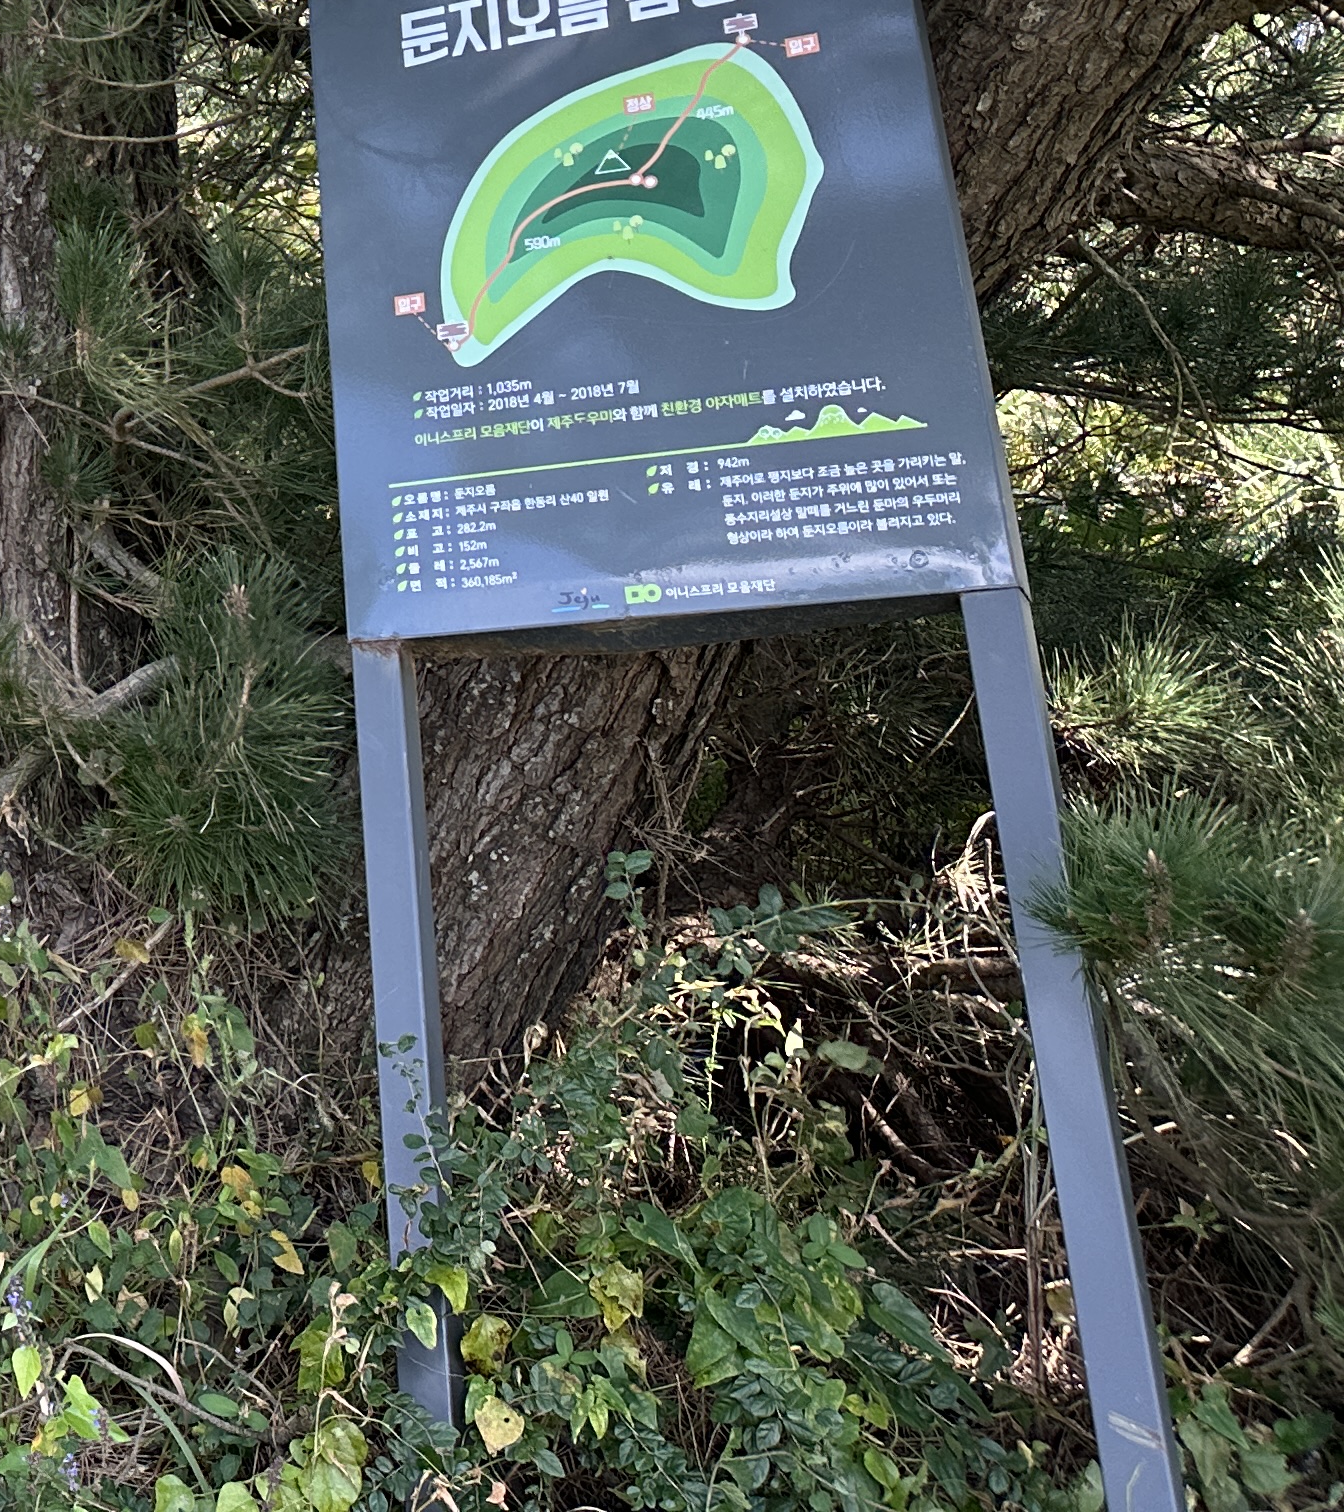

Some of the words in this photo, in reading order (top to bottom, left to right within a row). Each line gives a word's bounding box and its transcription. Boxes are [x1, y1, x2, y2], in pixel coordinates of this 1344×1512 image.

[788, 36, 815, 54] 입구
[626, 95, 652, 113] 정상
[696, 104, 734, 120] 445m
[524, 236, 561, 250] 590m
[425, 385, 474, 403] 작업거리
[486, 379, 532, 396] 1,035m
[488, 394, 529, 411] 2018년
[534, 392, 554, 405] 4월
[571, 383, 613, 401] 2018년
[618, 379, 639, 394] 7월
[415, 427, 476, 446] 이니스프리
[480, 419, 544, 438] 모음재단이
[630, 404, 658, 421] 함께
[661, 399, 703, 416] 친환경
[705, 389, 776, 410] 야자매트를
[780, 376, 886, 403] 설치하였습니다.
[717, 457, 749, 469] 942m
[720, 473, 764, 487] 제주어로
[768, 467, 814, 484] 평지보다
[818, 464, 841, 477] 조금
[844, 461, 868, 475] 높은
[871, 459, 894, 473] 곳을
[898, 454, 946, 469] 가리키는
[455, 484, 496, 499] 둔지오름
[751, 489, 785, 505] 이러한
[789, 486, 824, 500] 둔지가
[827, 481, 862, 496] 주위에
[865, 479, 889, 493] 많이
[892, 474, 928, 489] 있어서
[932, 473, 957, 485] 또는
[456, 504, 486, 516] 제주시
[490, 498, 522, 513] 구좌읍
[525, 493, 556, 509] 한동리
[559, 492, 584, 506] 산40
[587, 489, 609, 502] 일원
[724, 507, 792, 526] 풍수지리설상
[834, 500, 869, 514] 거느린
[873, 496, 909, 511] 둔마의
[912, 491, 960, 507] 우두머리
[457, 521, 496, 534] 282.2m
[776, 525, 799, 538] 하여
[803, 519, 873, 537] 둔지오름이라
[876, 515, 924, 530] 불려지고
[927, 512, 956, 526] 있다.
[407, 545, 419, 556] 비
[459, 540, 487, 552] 152m
[460, 557, 499, 571] 2,567m
[665, 583, 723, 599] 이니스프리
[727, 579, 775, 594] 모음재단
